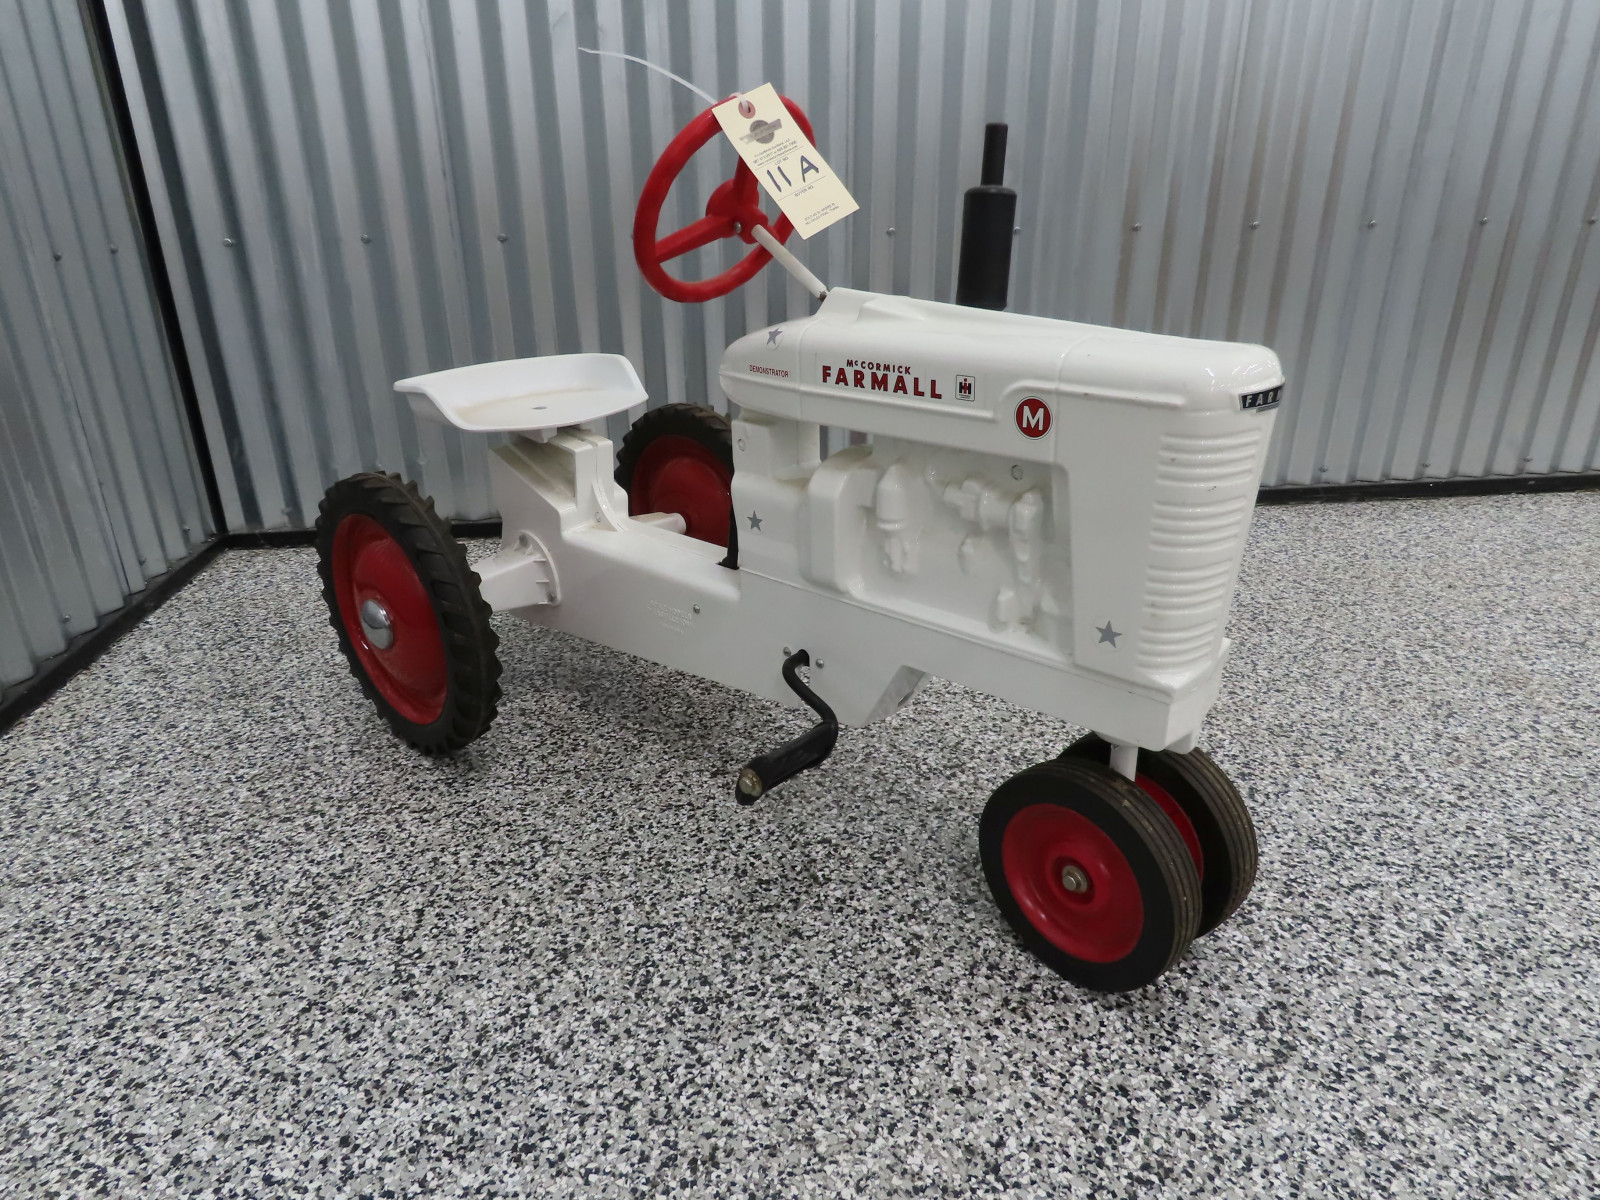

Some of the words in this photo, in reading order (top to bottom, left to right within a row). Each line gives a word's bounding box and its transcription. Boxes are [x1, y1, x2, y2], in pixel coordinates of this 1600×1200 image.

[800, 154, 819, 183] A
[749, 364, 789, 378] DEMONSTRATOR
[822, 365, 942, 399] FARMALL
[1022, 405, 1045, 431] M
